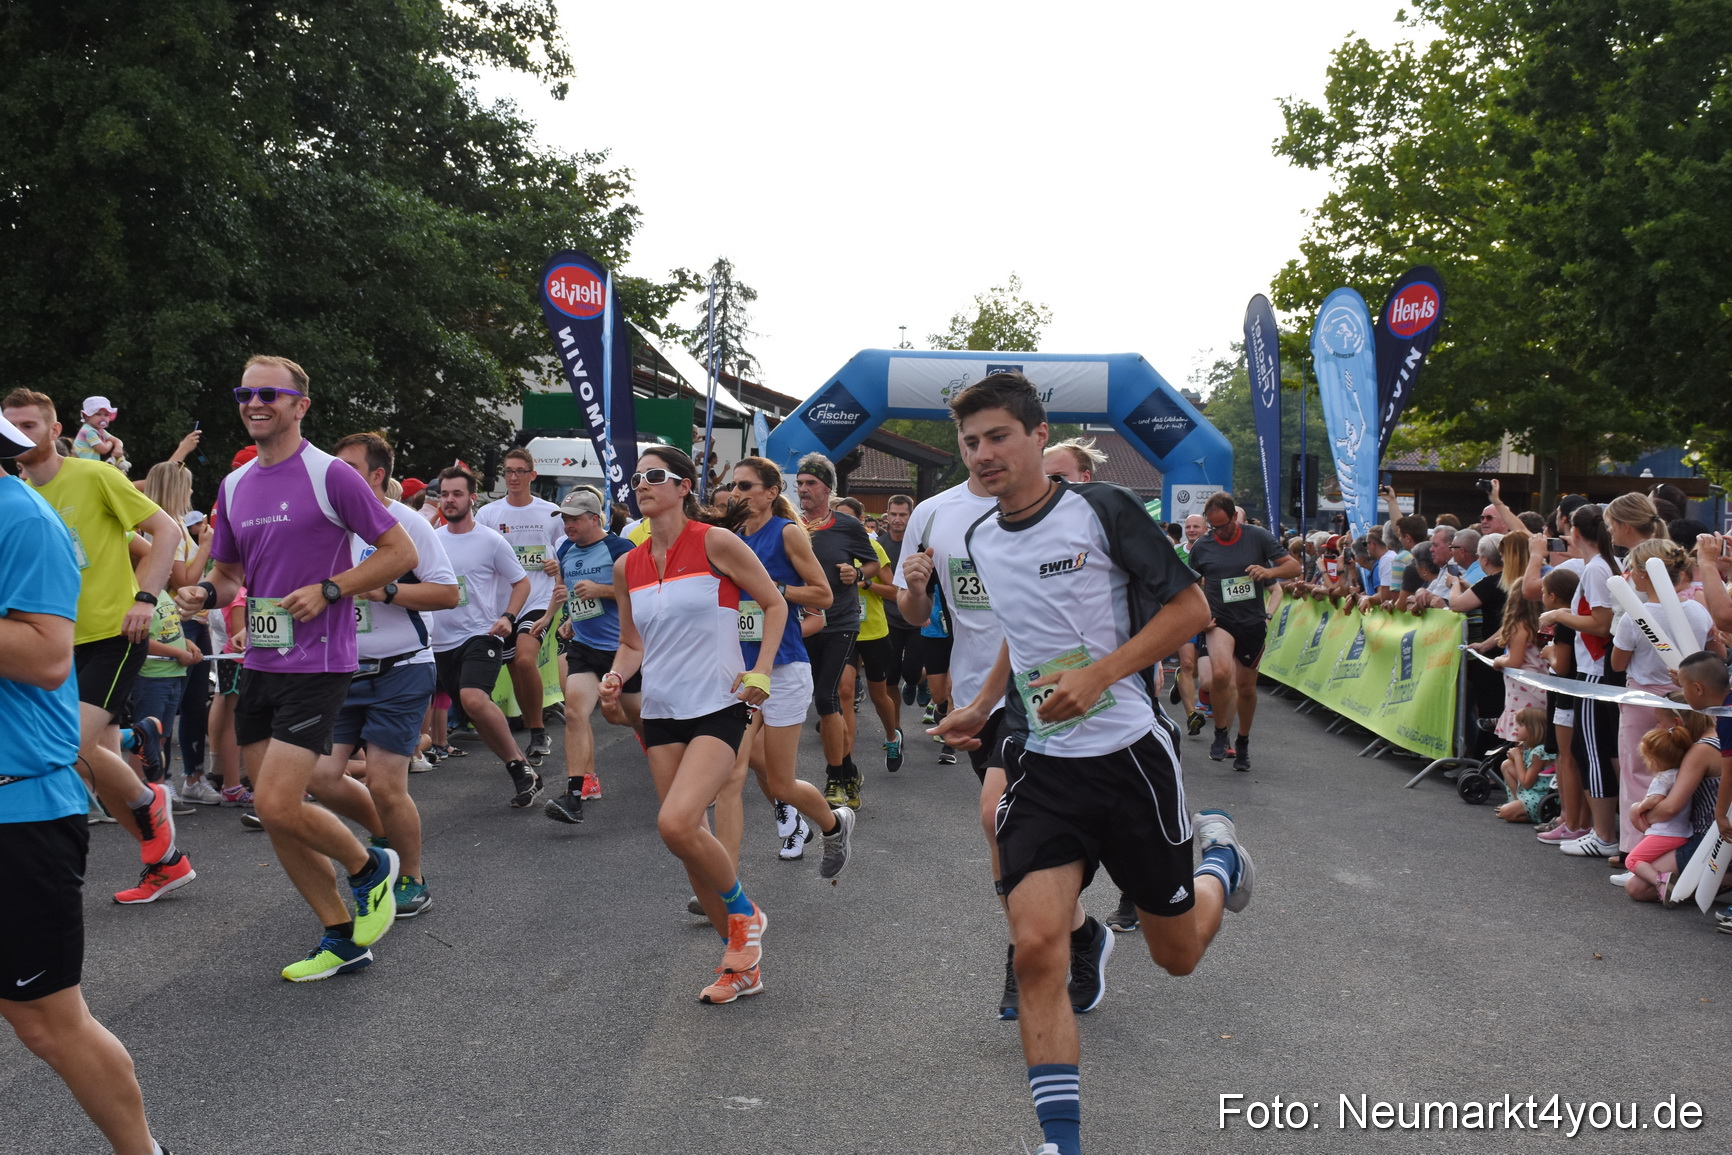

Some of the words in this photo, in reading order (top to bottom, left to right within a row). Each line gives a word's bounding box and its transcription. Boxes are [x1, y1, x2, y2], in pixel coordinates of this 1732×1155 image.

[1391, 296, 1435, 324] Hervis
[816, 409, 861, 420] Fischer
[241, 519, 254, 528] WIR
[255, 516, 272, 526] SIND
[272, 514, 291, 522] LILA.
[1039, 558, 1074, 575] swn
[1226, 583, 1251, 596] 1489
[570, 599, 596, 613] 2118
[738, 615, 755, 631] 60
[1634, 617, 1660, 644] swn
